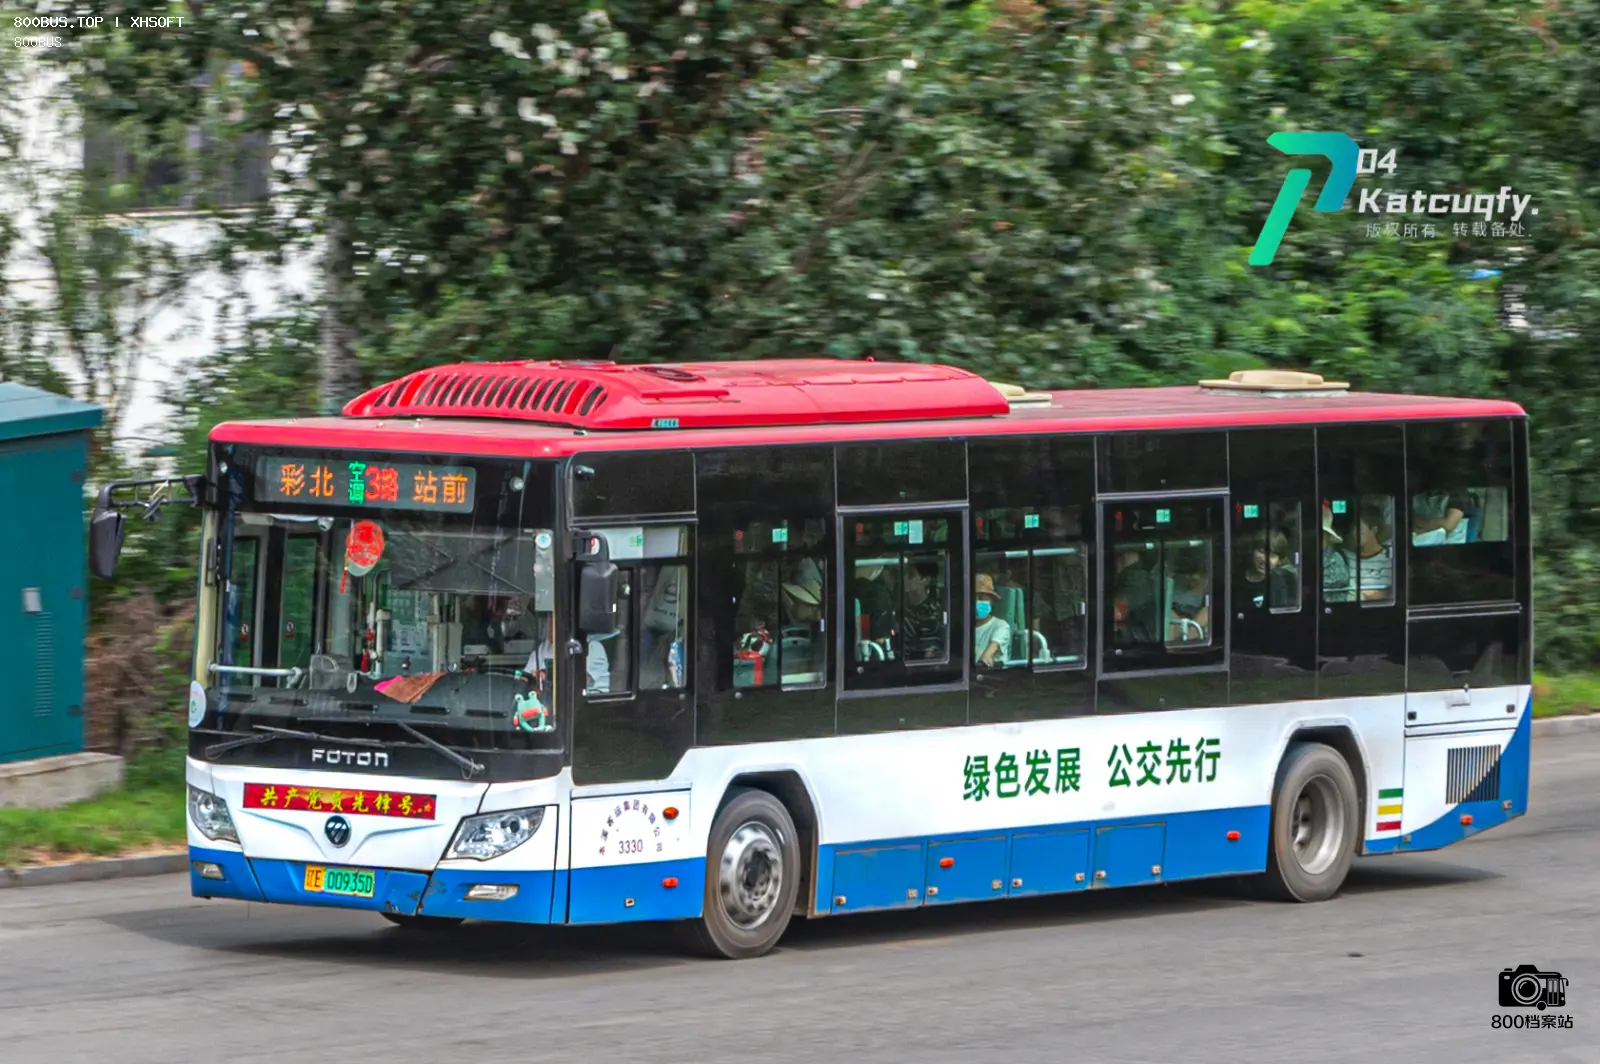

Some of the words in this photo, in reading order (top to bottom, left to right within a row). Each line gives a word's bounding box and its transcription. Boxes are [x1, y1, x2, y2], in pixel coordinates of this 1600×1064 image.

[280, 464, 335, 497] 彩北
[413, 469, 469, 504] 站前
[311, 749, 389, 768] FOTON
[962, 747, 1081, 802] 绿色发展
[1107, 737, 1222, 788] 公交先行
[260, 786, 414, 816] 共产党员先锋号
[618, 839, 644, 855] 3330
